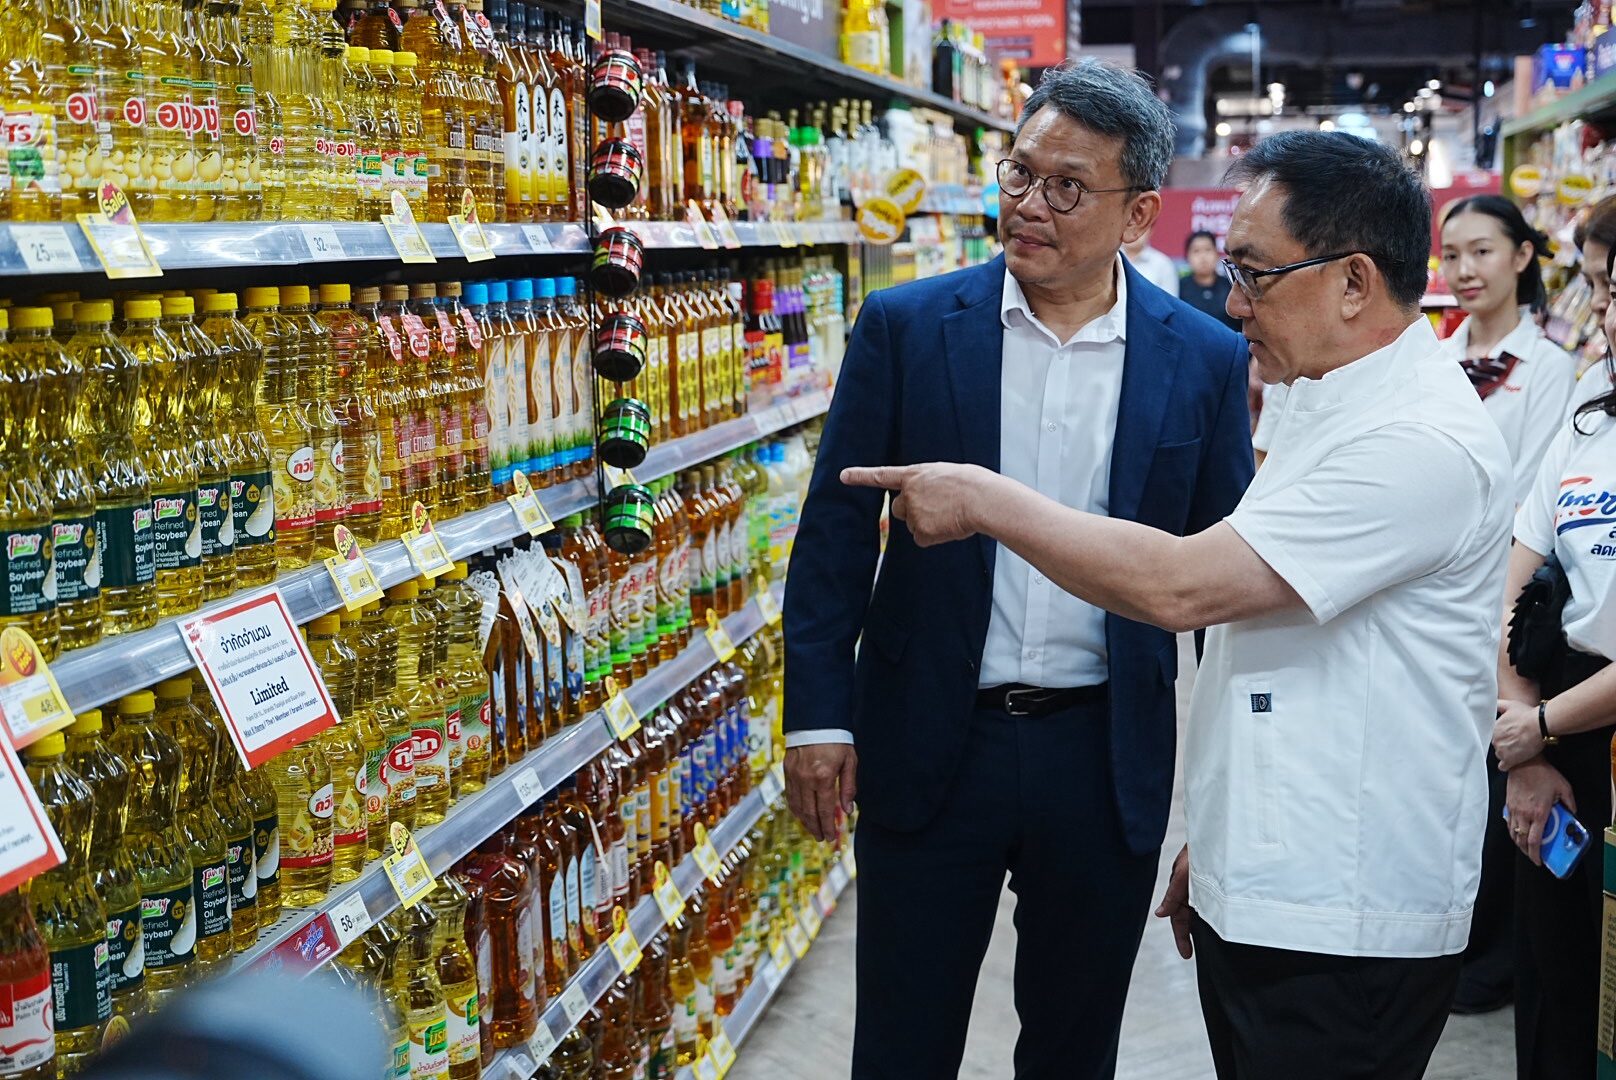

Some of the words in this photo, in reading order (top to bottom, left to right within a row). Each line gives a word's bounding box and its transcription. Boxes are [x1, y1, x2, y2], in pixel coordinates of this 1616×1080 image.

[102, 191, 126, 218] Sale
[155, 521, 184, 530] Refined
[200, 520, 221, 530] ybean
[155, 531, 187, 541] Soybean
[340, 532, 354, 556] Sale
[136, 555, 144, 563] Oil
[8, 560, 41, 570] Refined
[9, 570, 45, 583] Soybean
[10, 584, 23, 593] Oil
[221, 624, 271, 654] จำกัดจำนวน
[250, 676, 290, 706] Limited
[203, 887, 225, 899] Refined
[143, 920, 168, 930] efined
[341, 914, 353, 932] 58
[144, 929, 173, 940] oybean
[15, 1012, 32, 1021] Palm
[32, 1007, 41, 1015] Oil
